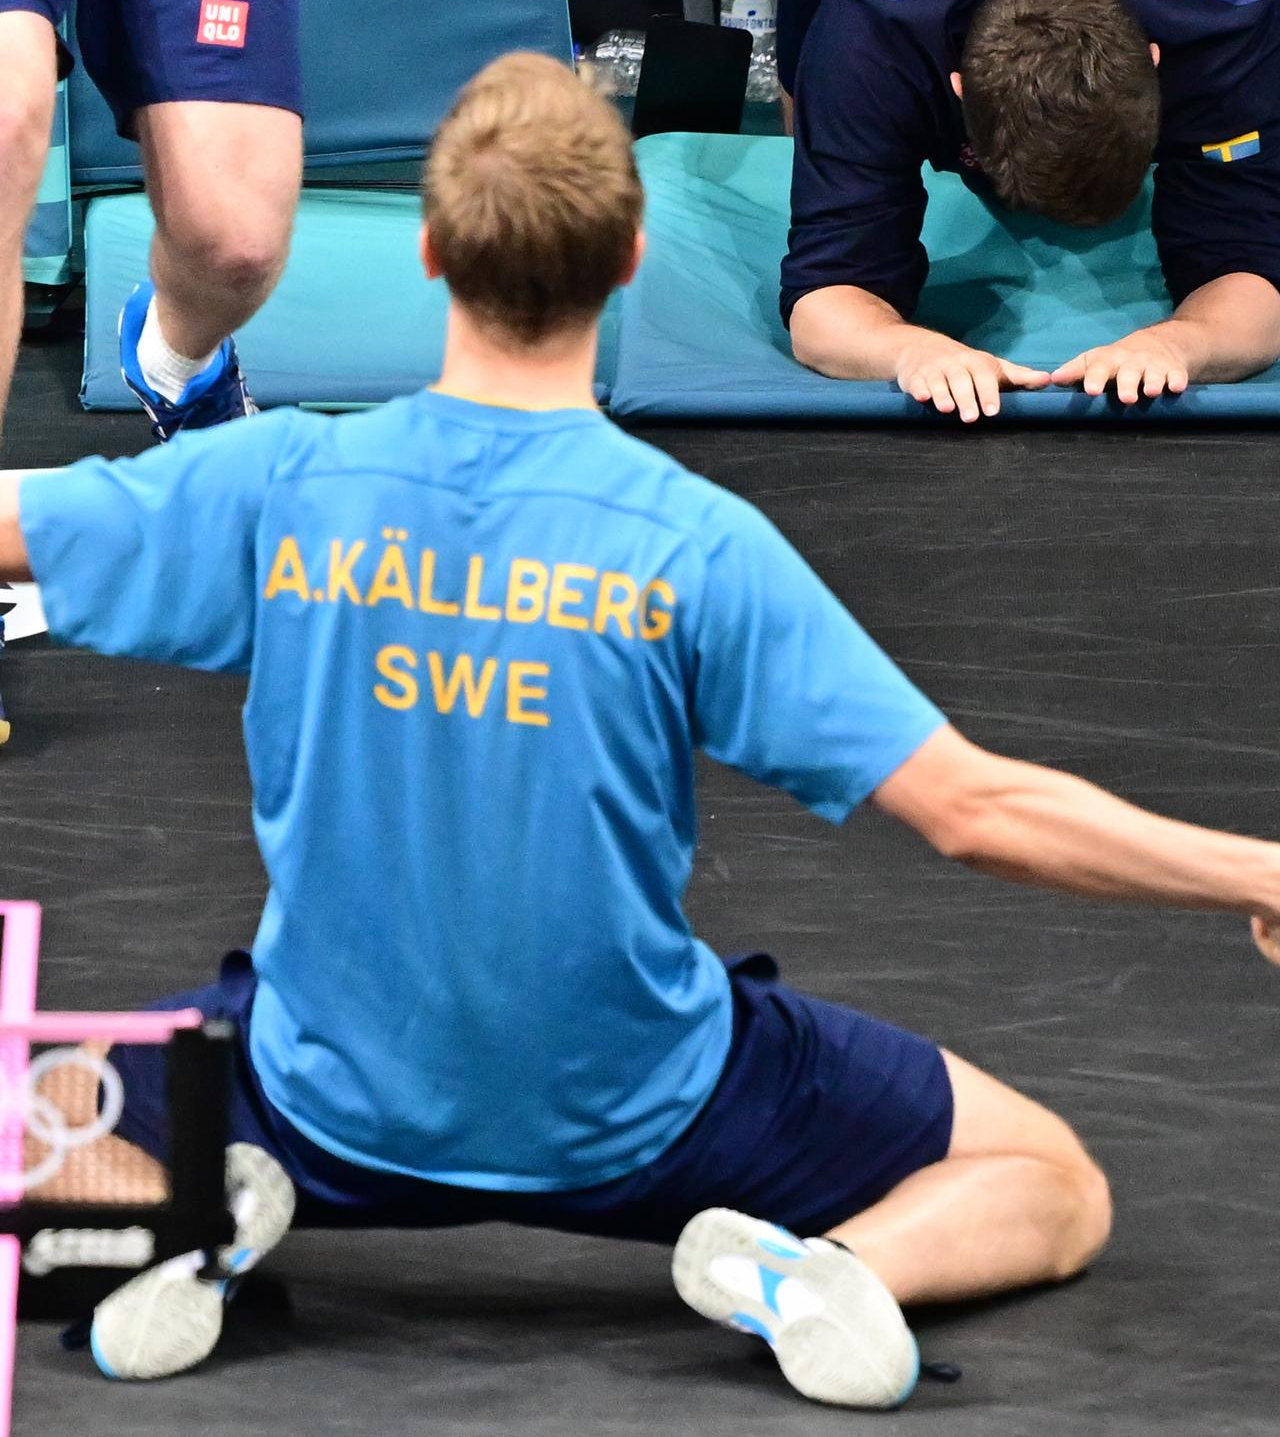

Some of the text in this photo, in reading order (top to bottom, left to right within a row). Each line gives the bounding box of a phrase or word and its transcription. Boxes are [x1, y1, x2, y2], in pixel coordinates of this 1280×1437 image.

[202, 22, 240, 42] QLO
[204, 3, 239, 23] UNI
[263, 527, 676, 641] A.KÄLLBERG
[373, 643, 551, 727] SWE
